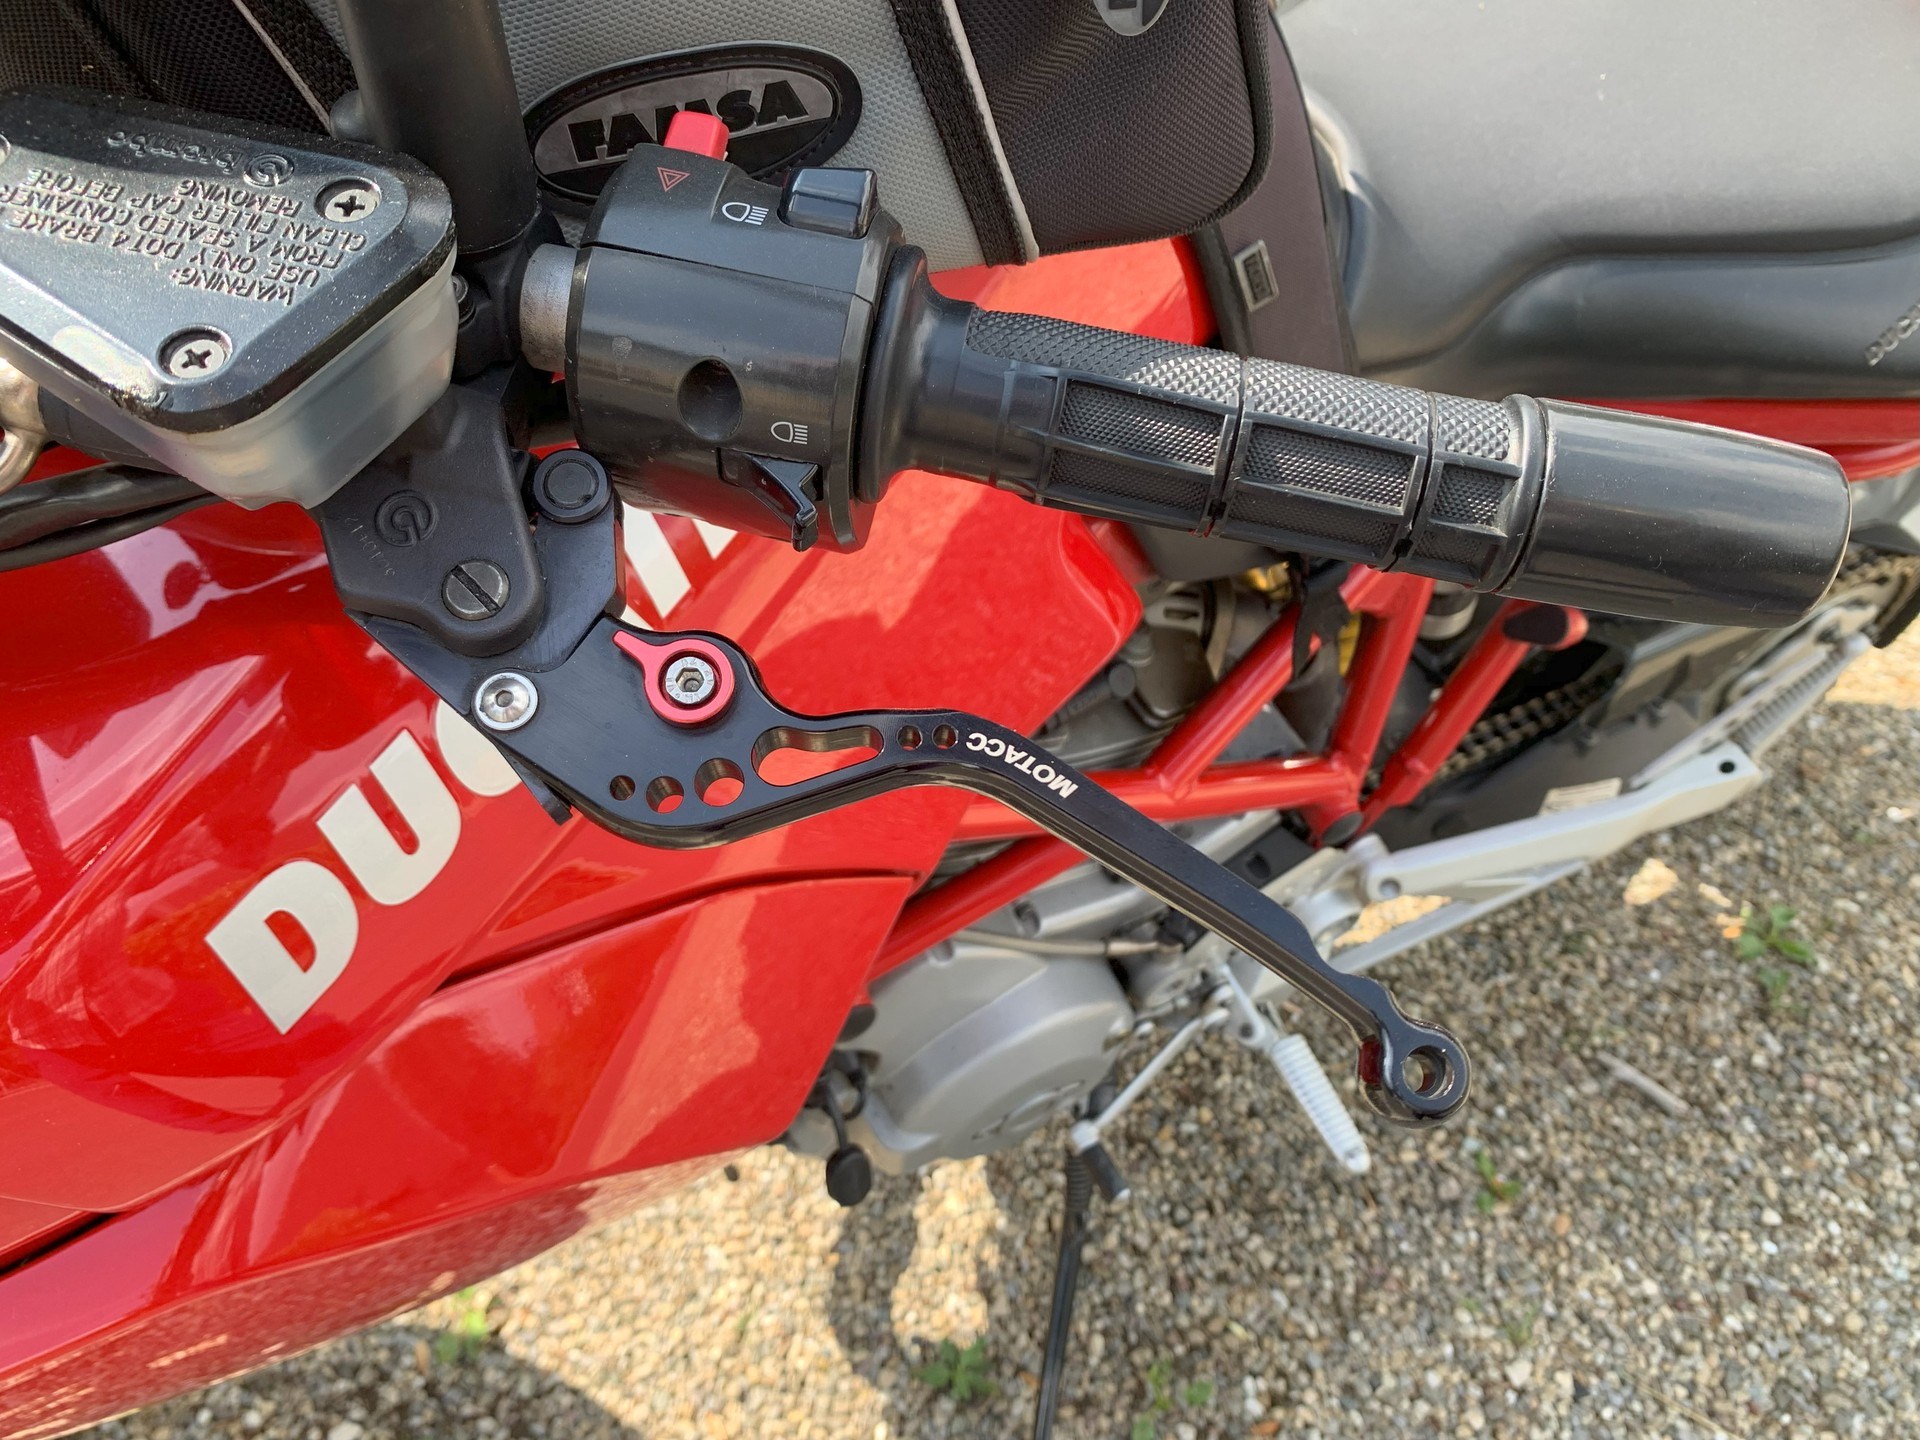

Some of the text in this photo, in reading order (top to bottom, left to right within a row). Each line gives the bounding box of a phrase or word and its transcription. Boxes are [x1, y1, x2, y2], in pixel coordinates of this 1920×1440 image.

[107, 131, 243, 175] brembo
[20, 167, 367, 251] CLEAN FILLER CAP BEFORE
[178, 179, 303, 218] REMOVING
[5, 209, 104, 243] BRAKE
[138, 214, 240, 248] SEALED
[188, 247, 257, 274] ONLY
[247, 234, 268, 253] A
[269, 240, 344, 269] FROM
[170, 266, 295, 306] WARNING:
[263, 261, 320, 289] USE
[965, 732, 1079, 799] MOTACC
